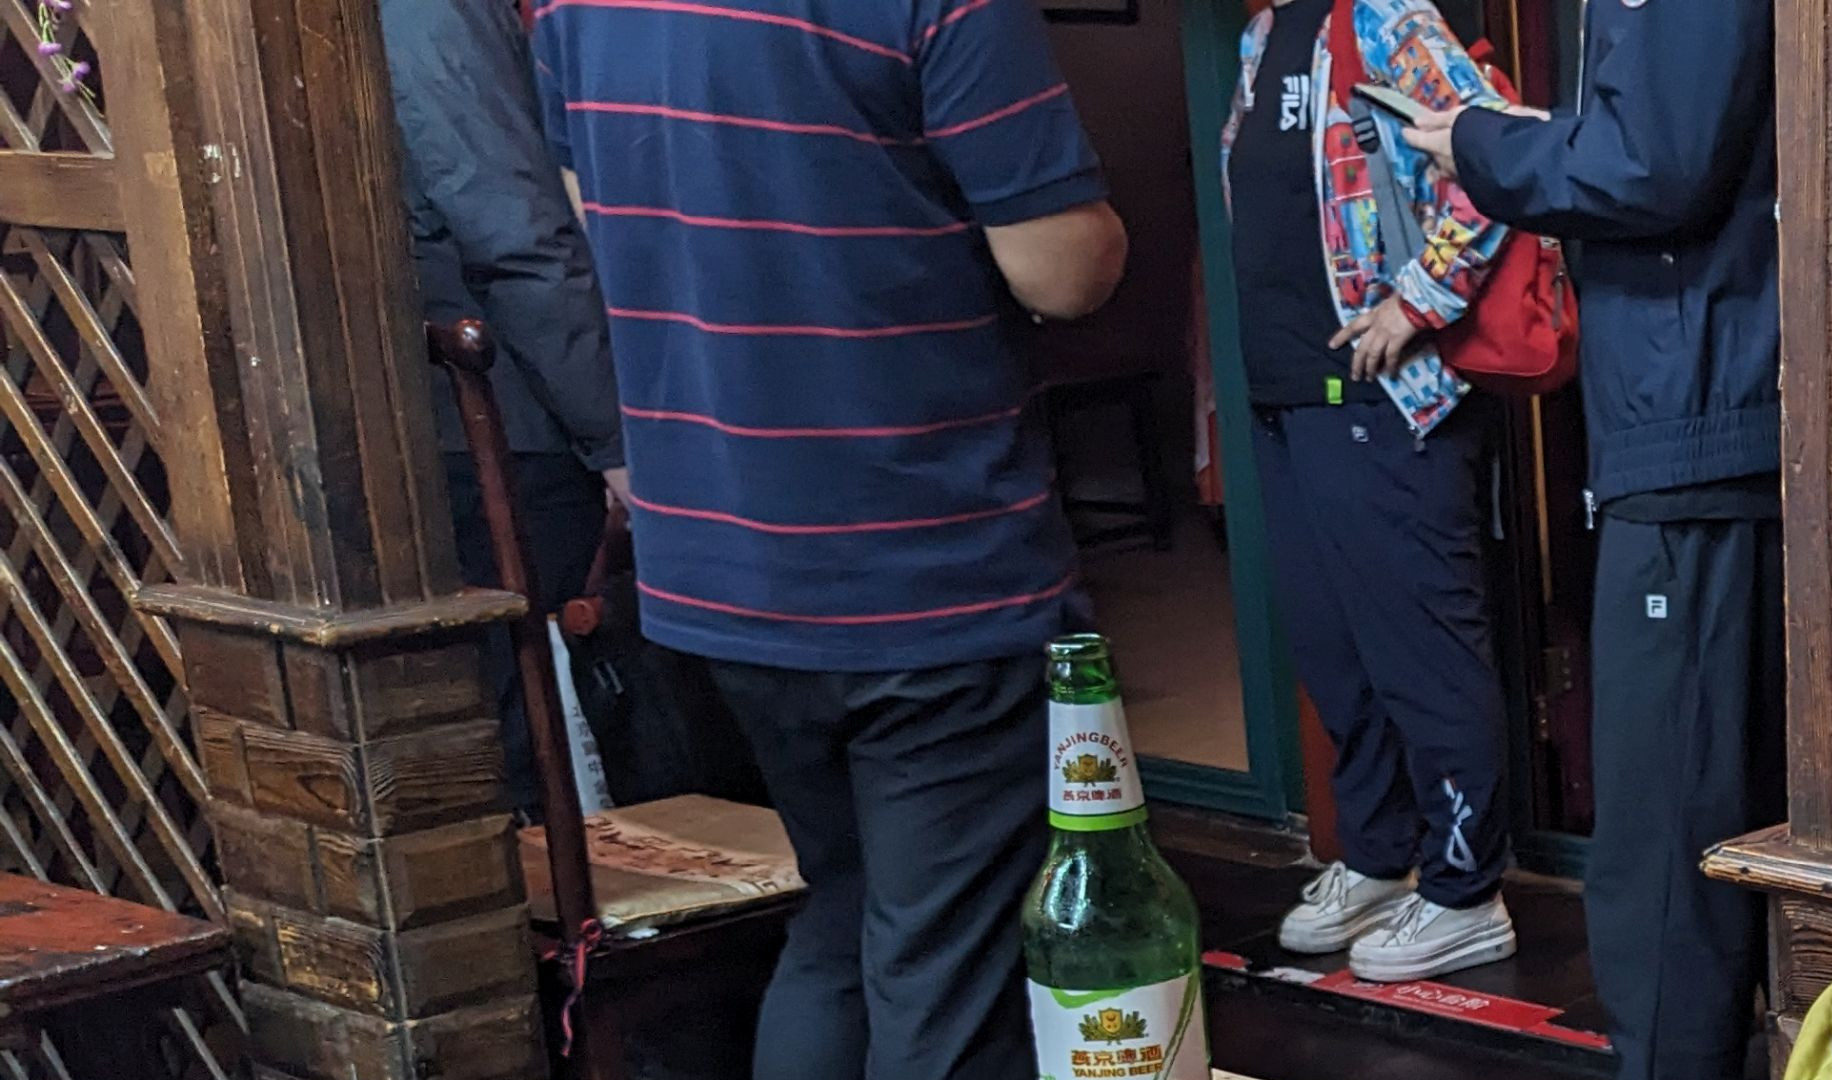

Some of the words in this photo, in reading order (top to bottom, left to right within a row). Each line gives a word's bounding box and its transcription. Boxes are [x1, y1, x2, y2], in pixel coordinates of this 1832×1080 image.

[1071, 1044, 1163, 1066] 燕京啤酒
[1072, 1067, 1127, 1078] YANJING
[1128, 1062, 1164, 1077] BEER
